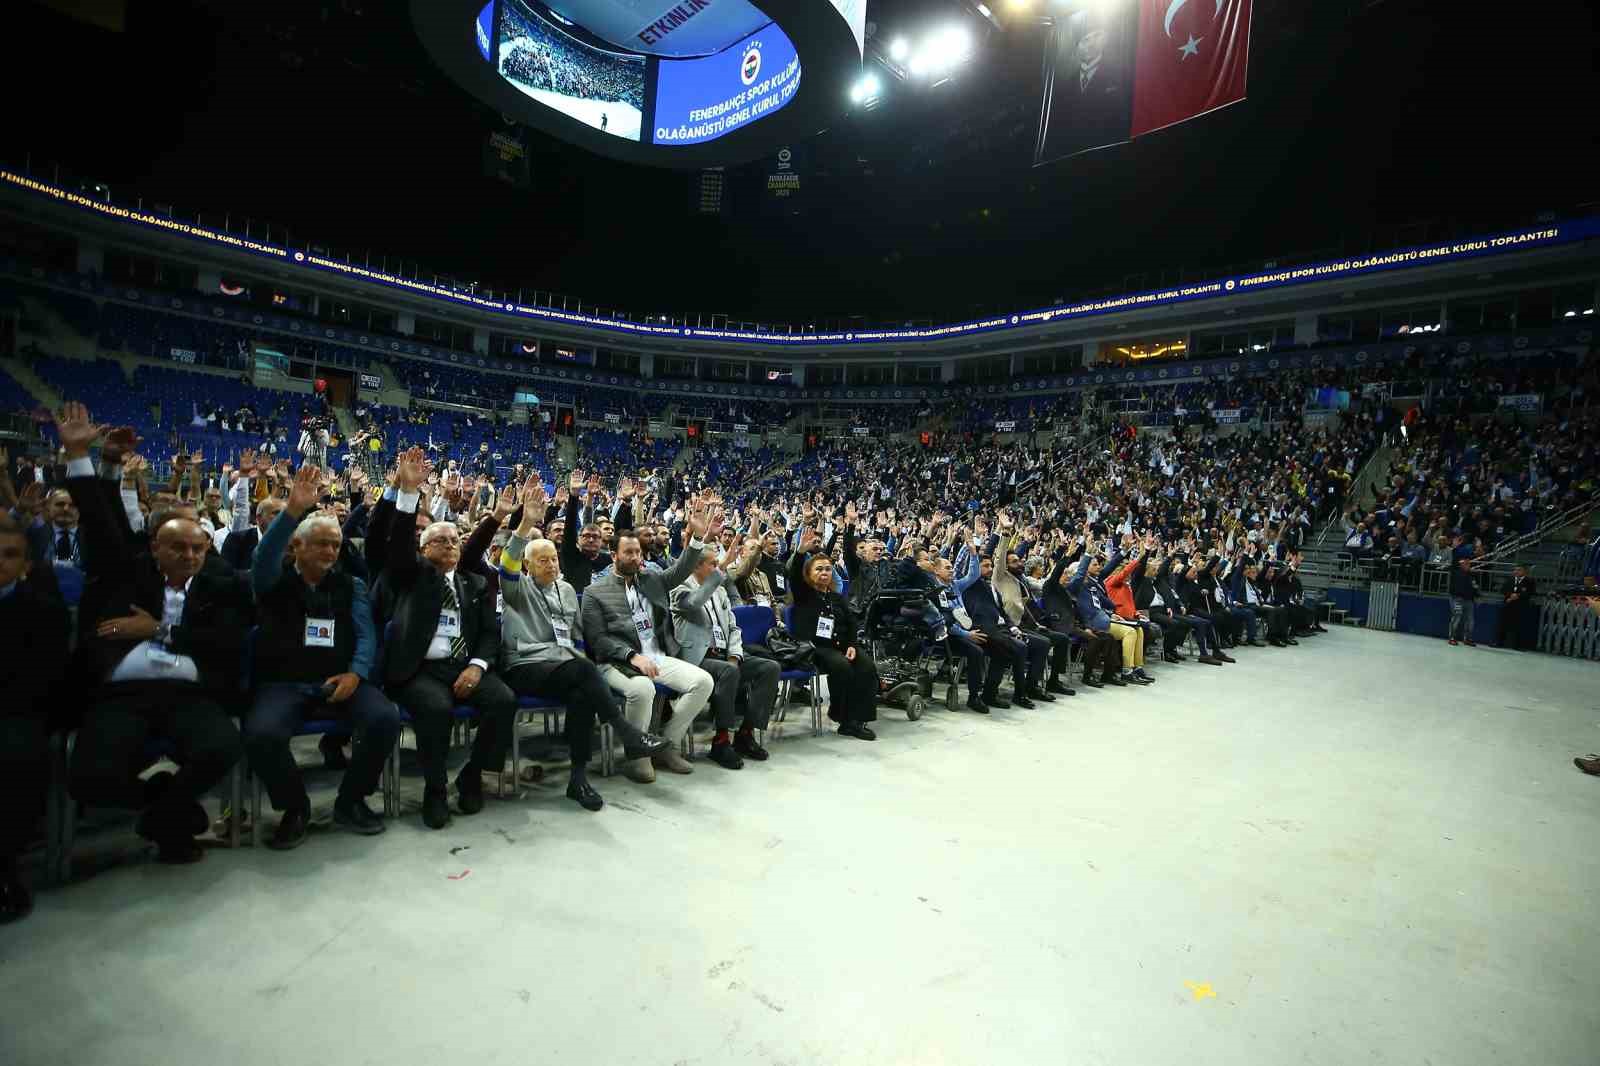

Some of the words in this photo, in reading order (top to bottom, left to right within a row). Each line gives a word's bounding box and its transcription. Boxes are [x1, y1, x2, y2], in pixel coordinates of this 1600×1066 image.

[656, 121, 726, 139] OLAĞANÜSTÜ
[725, 109, 751, 128] GENEL
[751, 97, 780, 116] KURUL
[689, 91, 746, 122] FENERBAHÇE
[747, 80, 770, 100] SPOR
[0, 170, 66, 199] FENERBAHÇE
[66, 192, 92, 207] SPOR
[93, 201, 130, 217] KULÜBÜ
[130, 212, 190, 233] OLAĞANÜSTÜ
[190, 227, 217, 240] GENEL
[217, 235, 243, 246] KURUL
[243, 241, 287, 257] TOPLANTISI
[352, 266, 370, 277] SPOR
[1239, 271, 1291, 287] FENERBAHÇE
[1291, 268, 1315, 279] SPOR
[1315, 260, 1351, 274] KULÜBÜ
[1351, 250, 1418, 269] OLAĞANÜSTÜ
[1418, 246, 1452, 259] GENEL
[1452, 240, 1489, 254] KURUL
[1489, 228, 1559, 247] TOPLANTISI
[1180, 283, 1221, 295] TOPLANTISI
